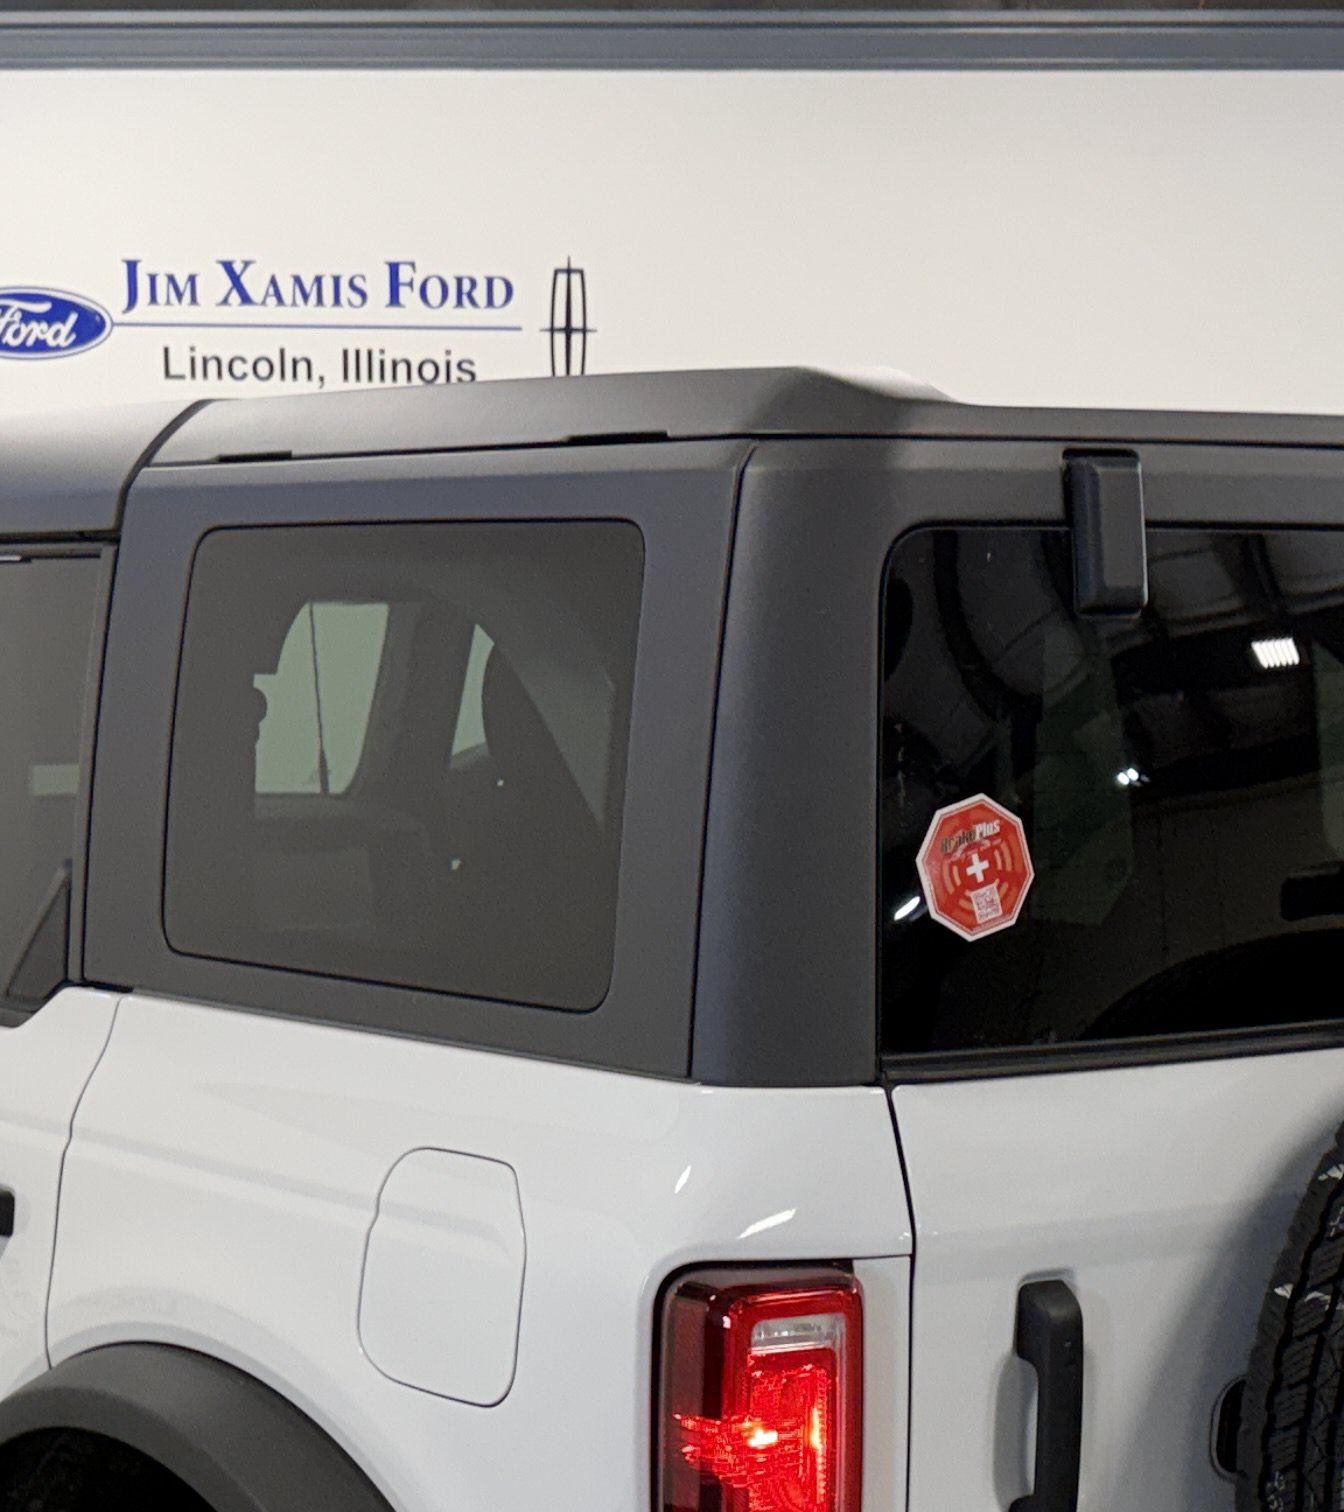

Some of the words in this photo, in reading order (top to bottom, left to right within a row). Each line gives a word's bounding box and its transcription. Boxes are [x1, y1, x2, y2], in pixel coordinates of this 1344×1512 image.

[121, 259, 199, 314] JIM
[215, 259, 368, 309] XAMIS
[384, 261, 514, 310] FORD
[163, 346, 325, 389] Lincoln,
[340, 348, 477, 385] Illinois
